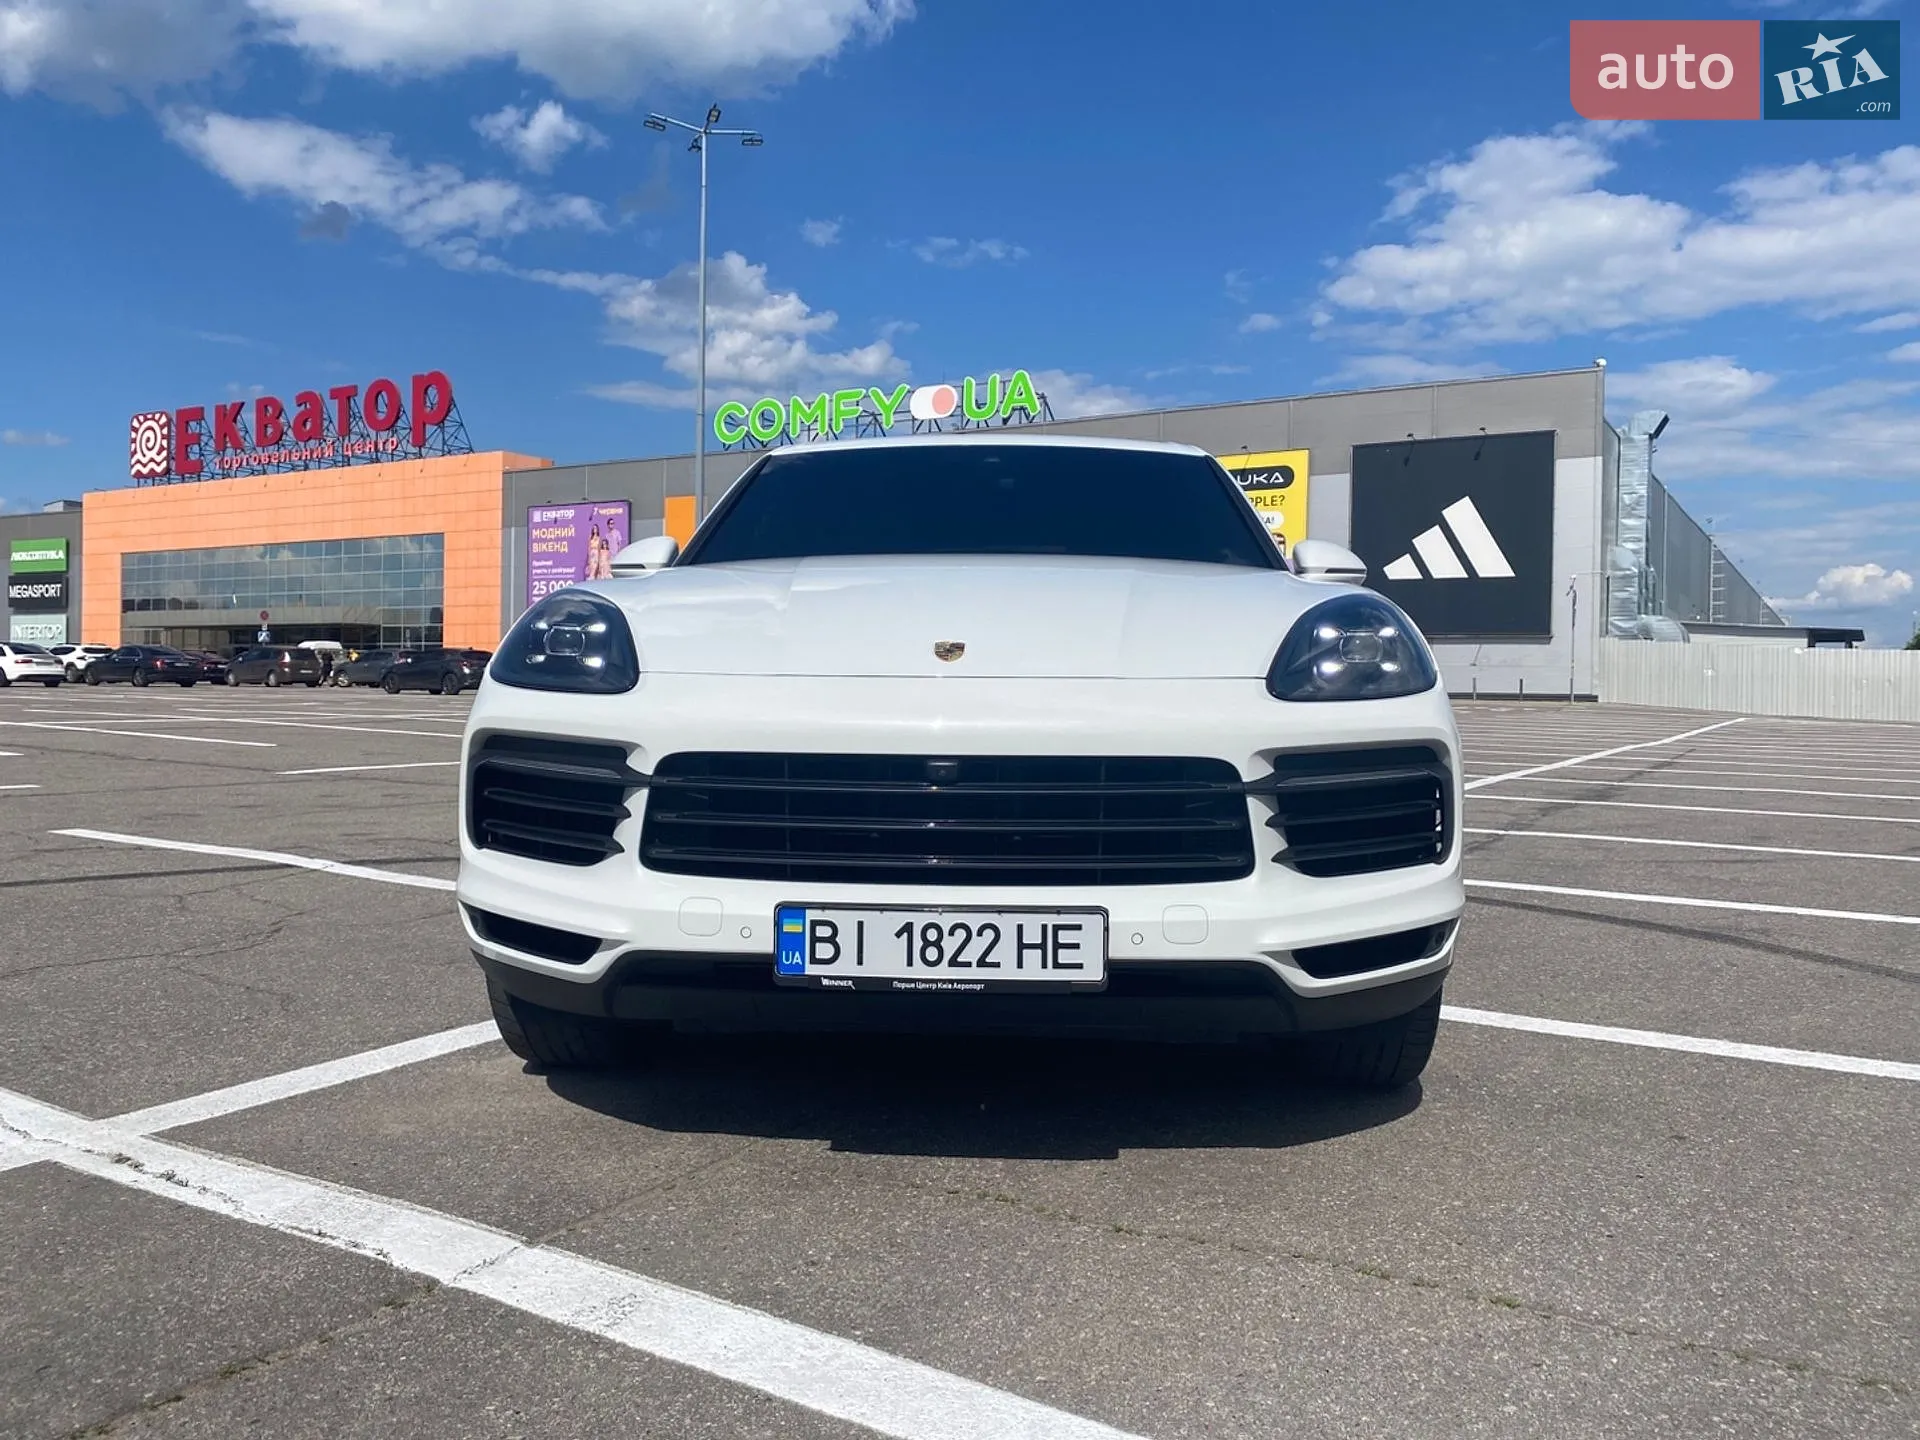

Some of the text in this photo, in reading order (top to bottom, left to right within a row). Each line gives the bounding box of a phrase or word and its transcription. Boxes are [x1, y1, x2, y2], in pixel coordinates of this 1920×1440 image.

[714, 369, 1041, 444] COMFY UA
[343, 437, 398, 457] центр
[1237, 472, 1284, 485] UKA
[532, 524, 575, 539] МОДНИЙ
[532, 541, 568, 553] ВІКЕНД
[9, 584, 62, 598] MEGASPORT
[532, 581, 547, 595] 25
[11, 624, 62, 640] INTERTOP
[809, 919, 1084, 970] BI 1822 HE
[782, 951, 802, 965] UA
